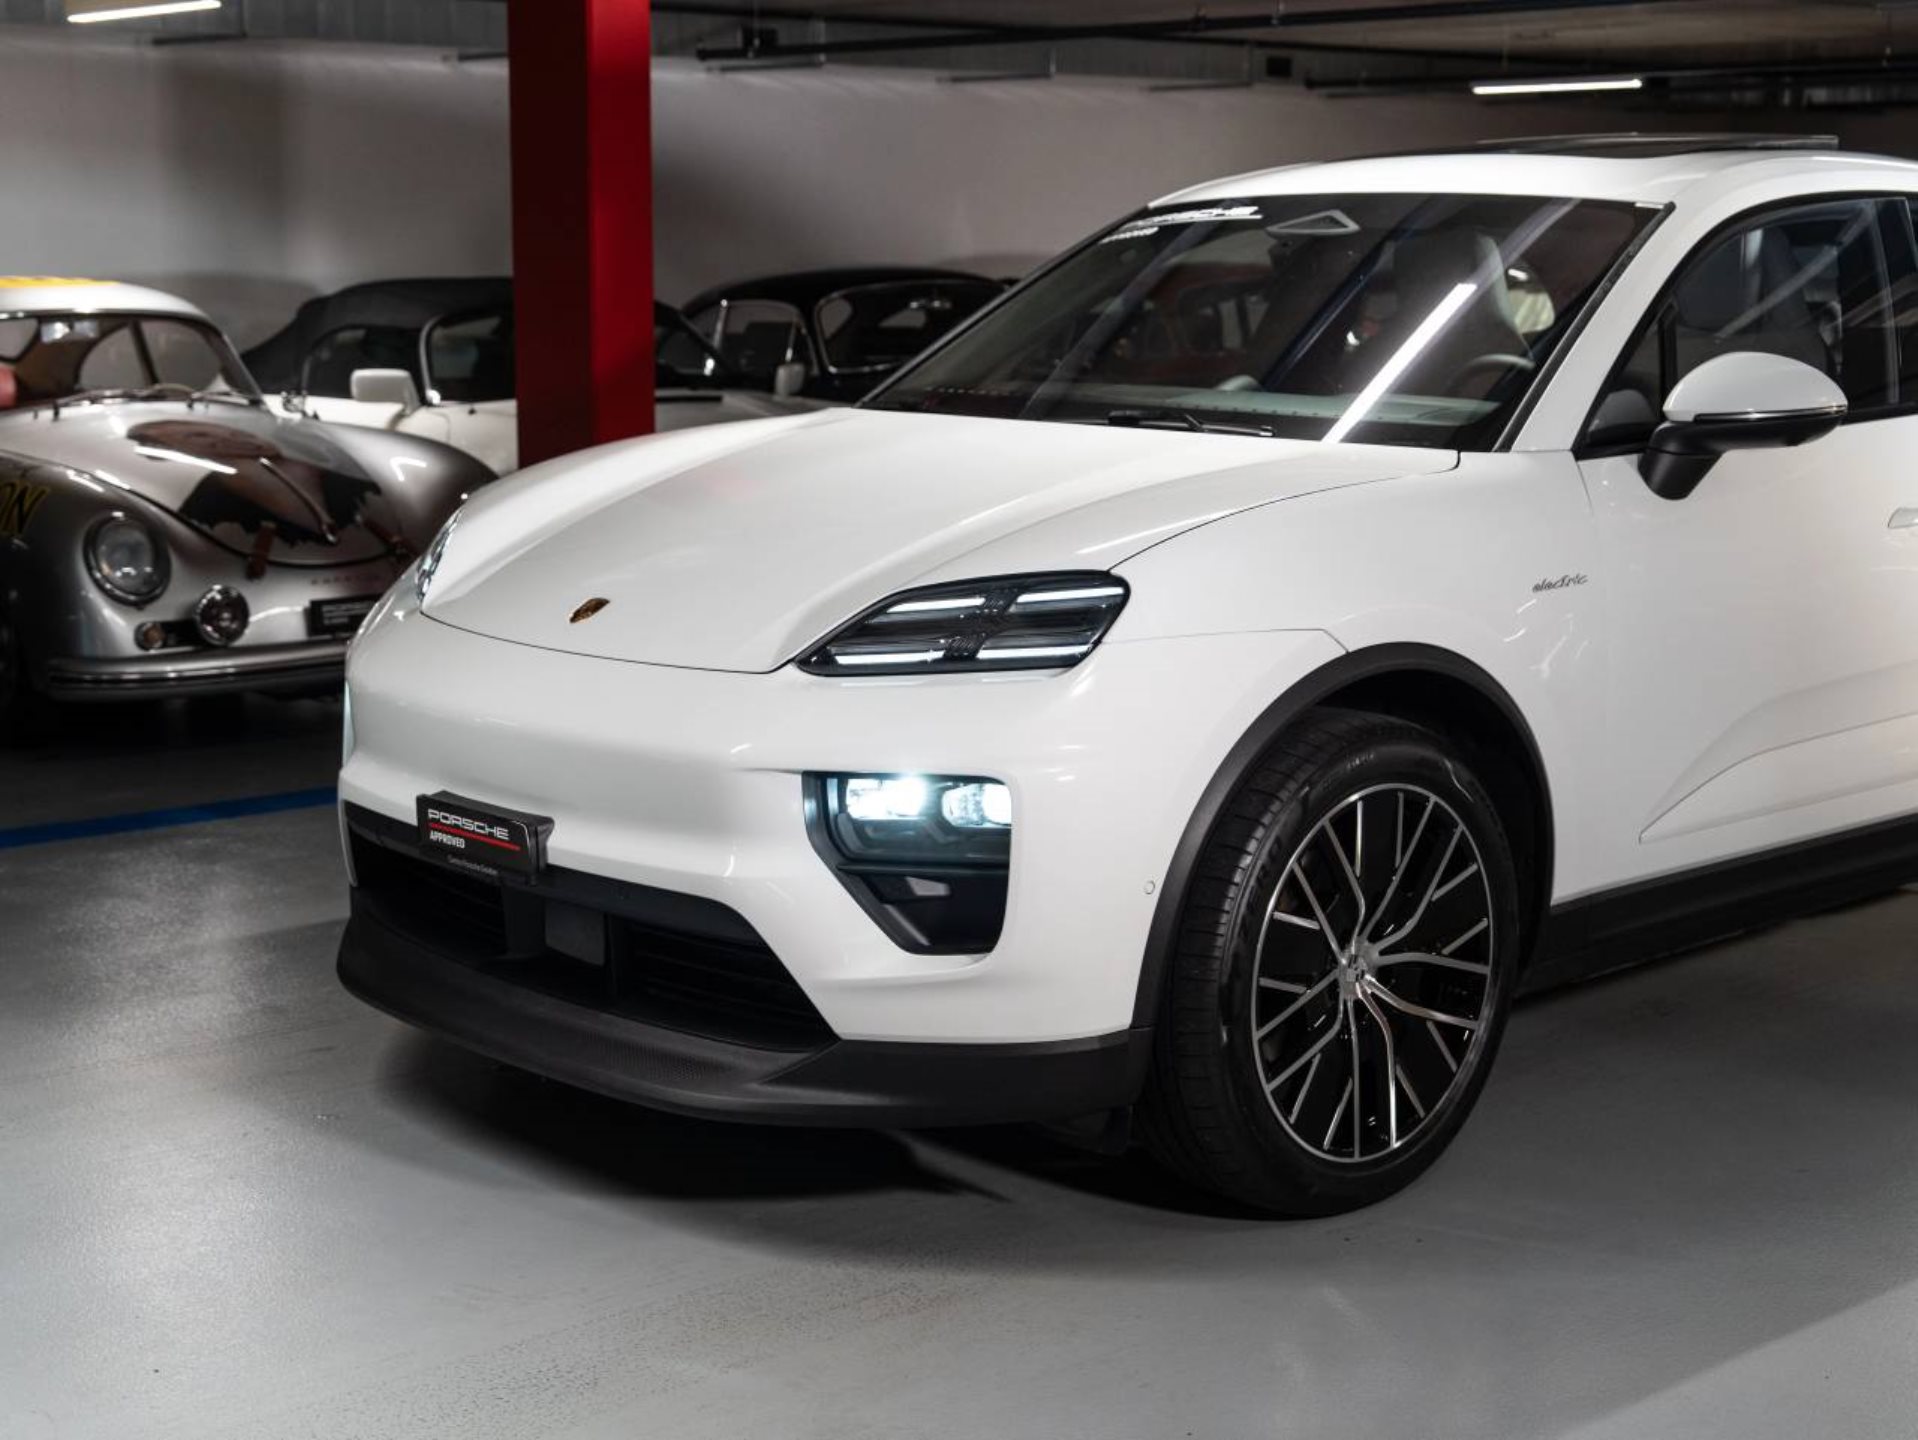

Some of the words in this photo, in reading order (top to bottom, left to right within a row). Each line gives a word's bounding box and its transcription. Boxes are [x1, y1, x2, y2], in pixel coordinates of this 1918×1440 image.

[1532, 573, 1588, 593] electric
[428, 808, 509, 840] PORSCHE
[430, 830, 465, 848] APPROVED
